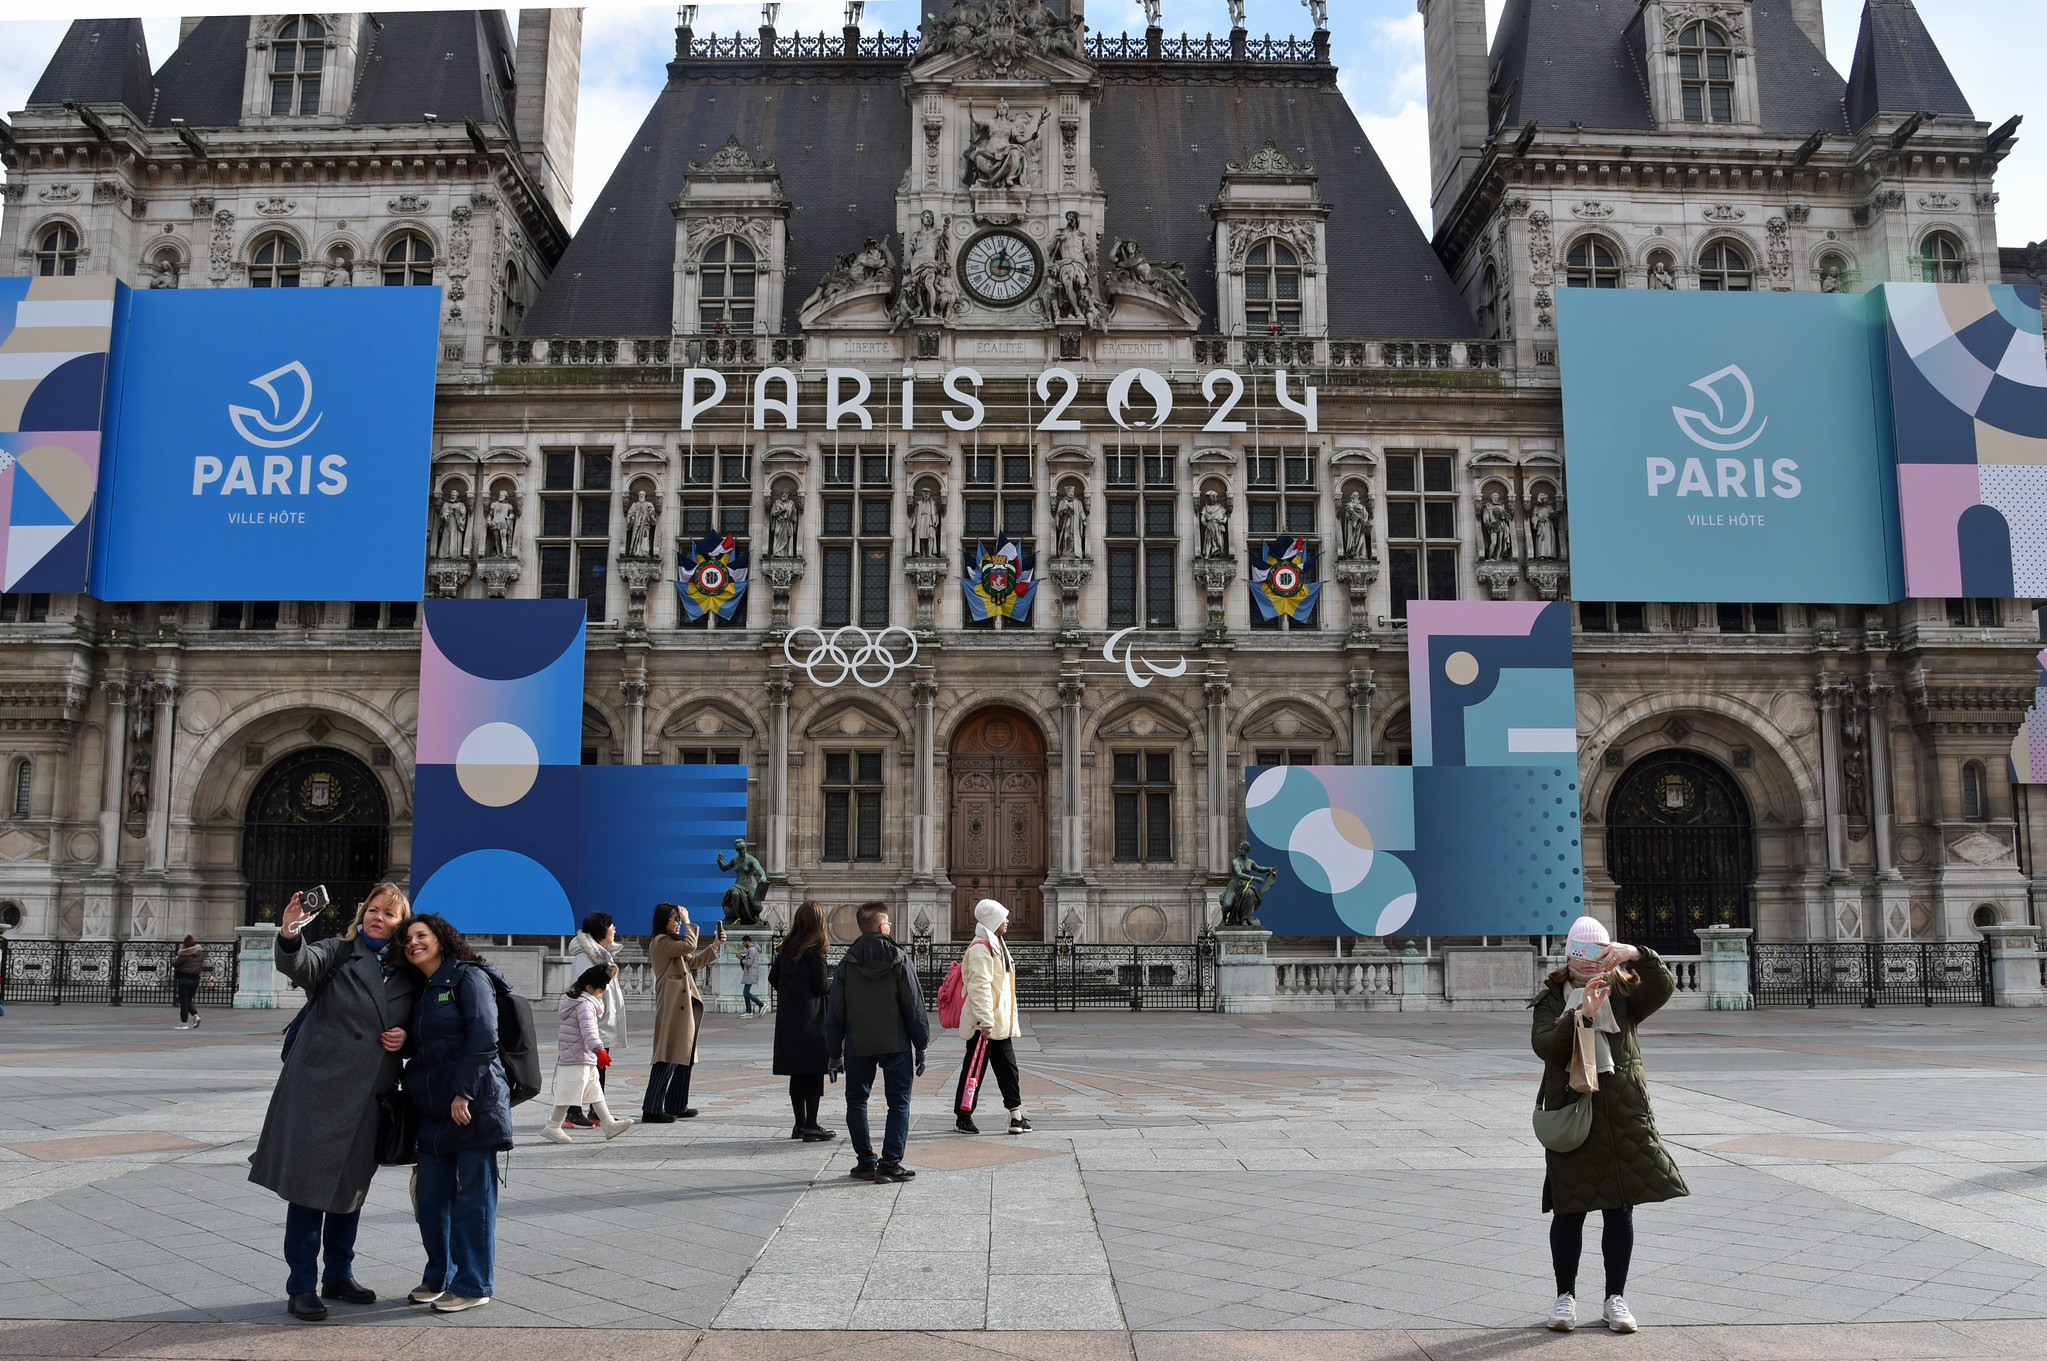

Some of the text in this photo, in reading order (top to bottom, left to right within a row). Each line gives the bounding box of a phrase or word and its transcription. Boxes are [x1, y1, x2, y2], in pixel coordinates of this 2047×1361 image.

[844, 341, 889, 353] LIBERTÉ
[1102, 342, 1164, 354] FRATERNITÉ
[1036, 367, 1317, 431] 2024
[192, 454, 348, 495] PARIS
[1646, 456, 1802, 498] PARIS
[228, 510, 306, 524] VILLE HÔTE
[1688, 512, 1766, 526] VILLE HÔTE
